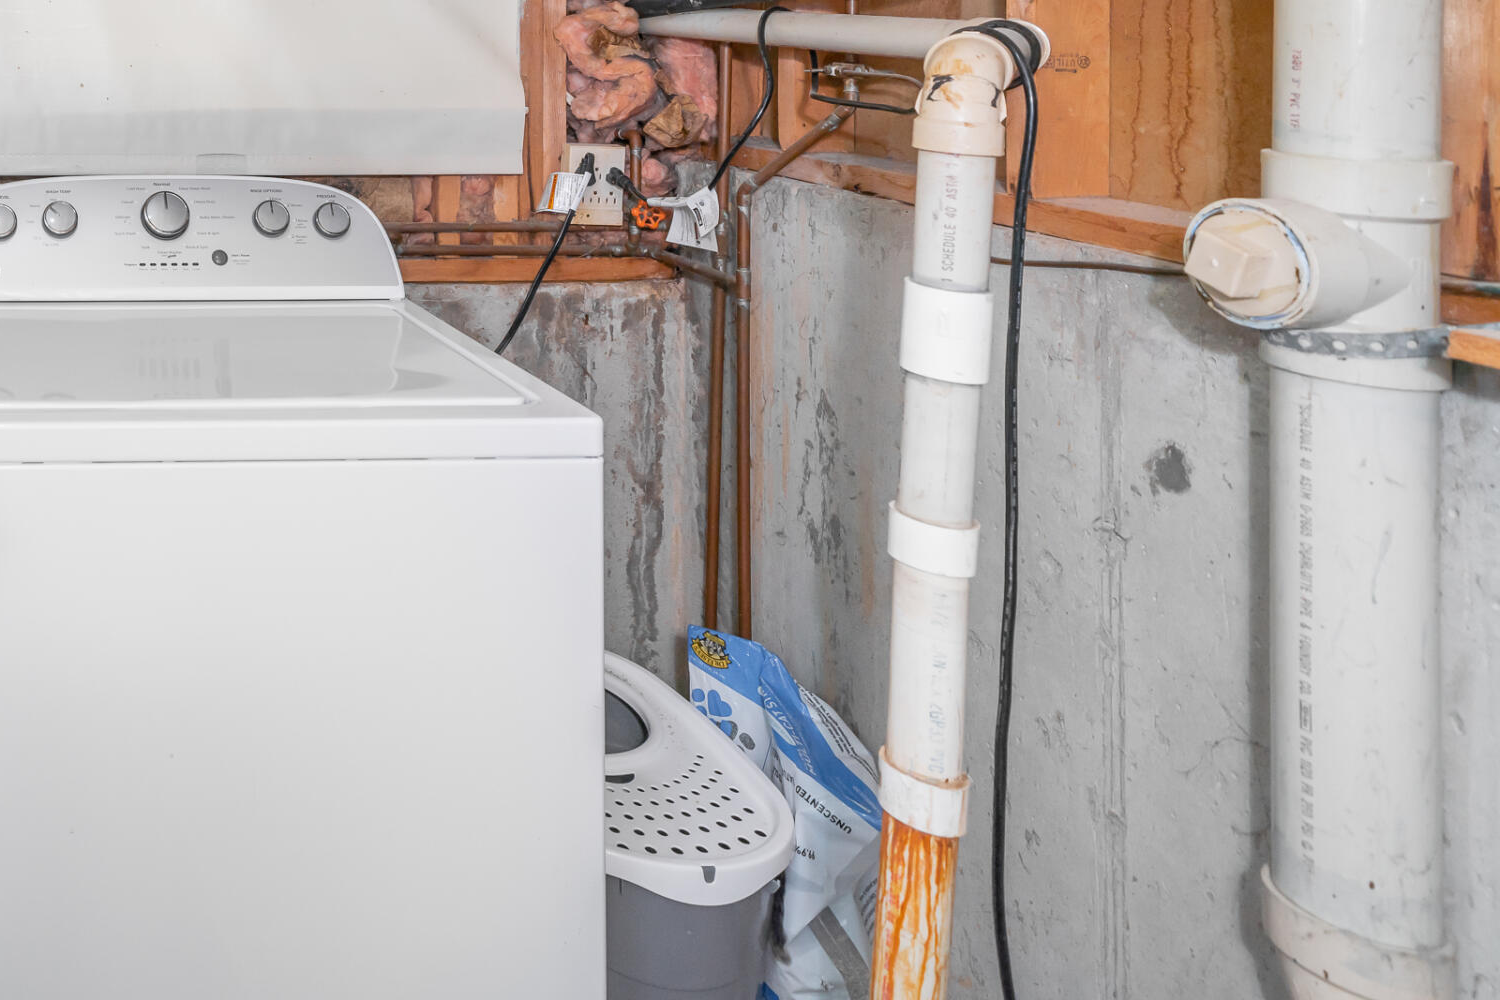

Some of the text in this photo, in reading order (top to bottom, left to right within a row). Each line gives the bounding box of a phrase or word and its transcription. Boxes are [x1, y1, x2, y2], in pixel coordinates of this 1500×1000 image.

[944, 175, 960, 200] ASTM
[944, 207, 958, 219] 40
[941, 224, 957, 273] SCHEDULE
[795, 783, 853, 835] UNSCENTED
